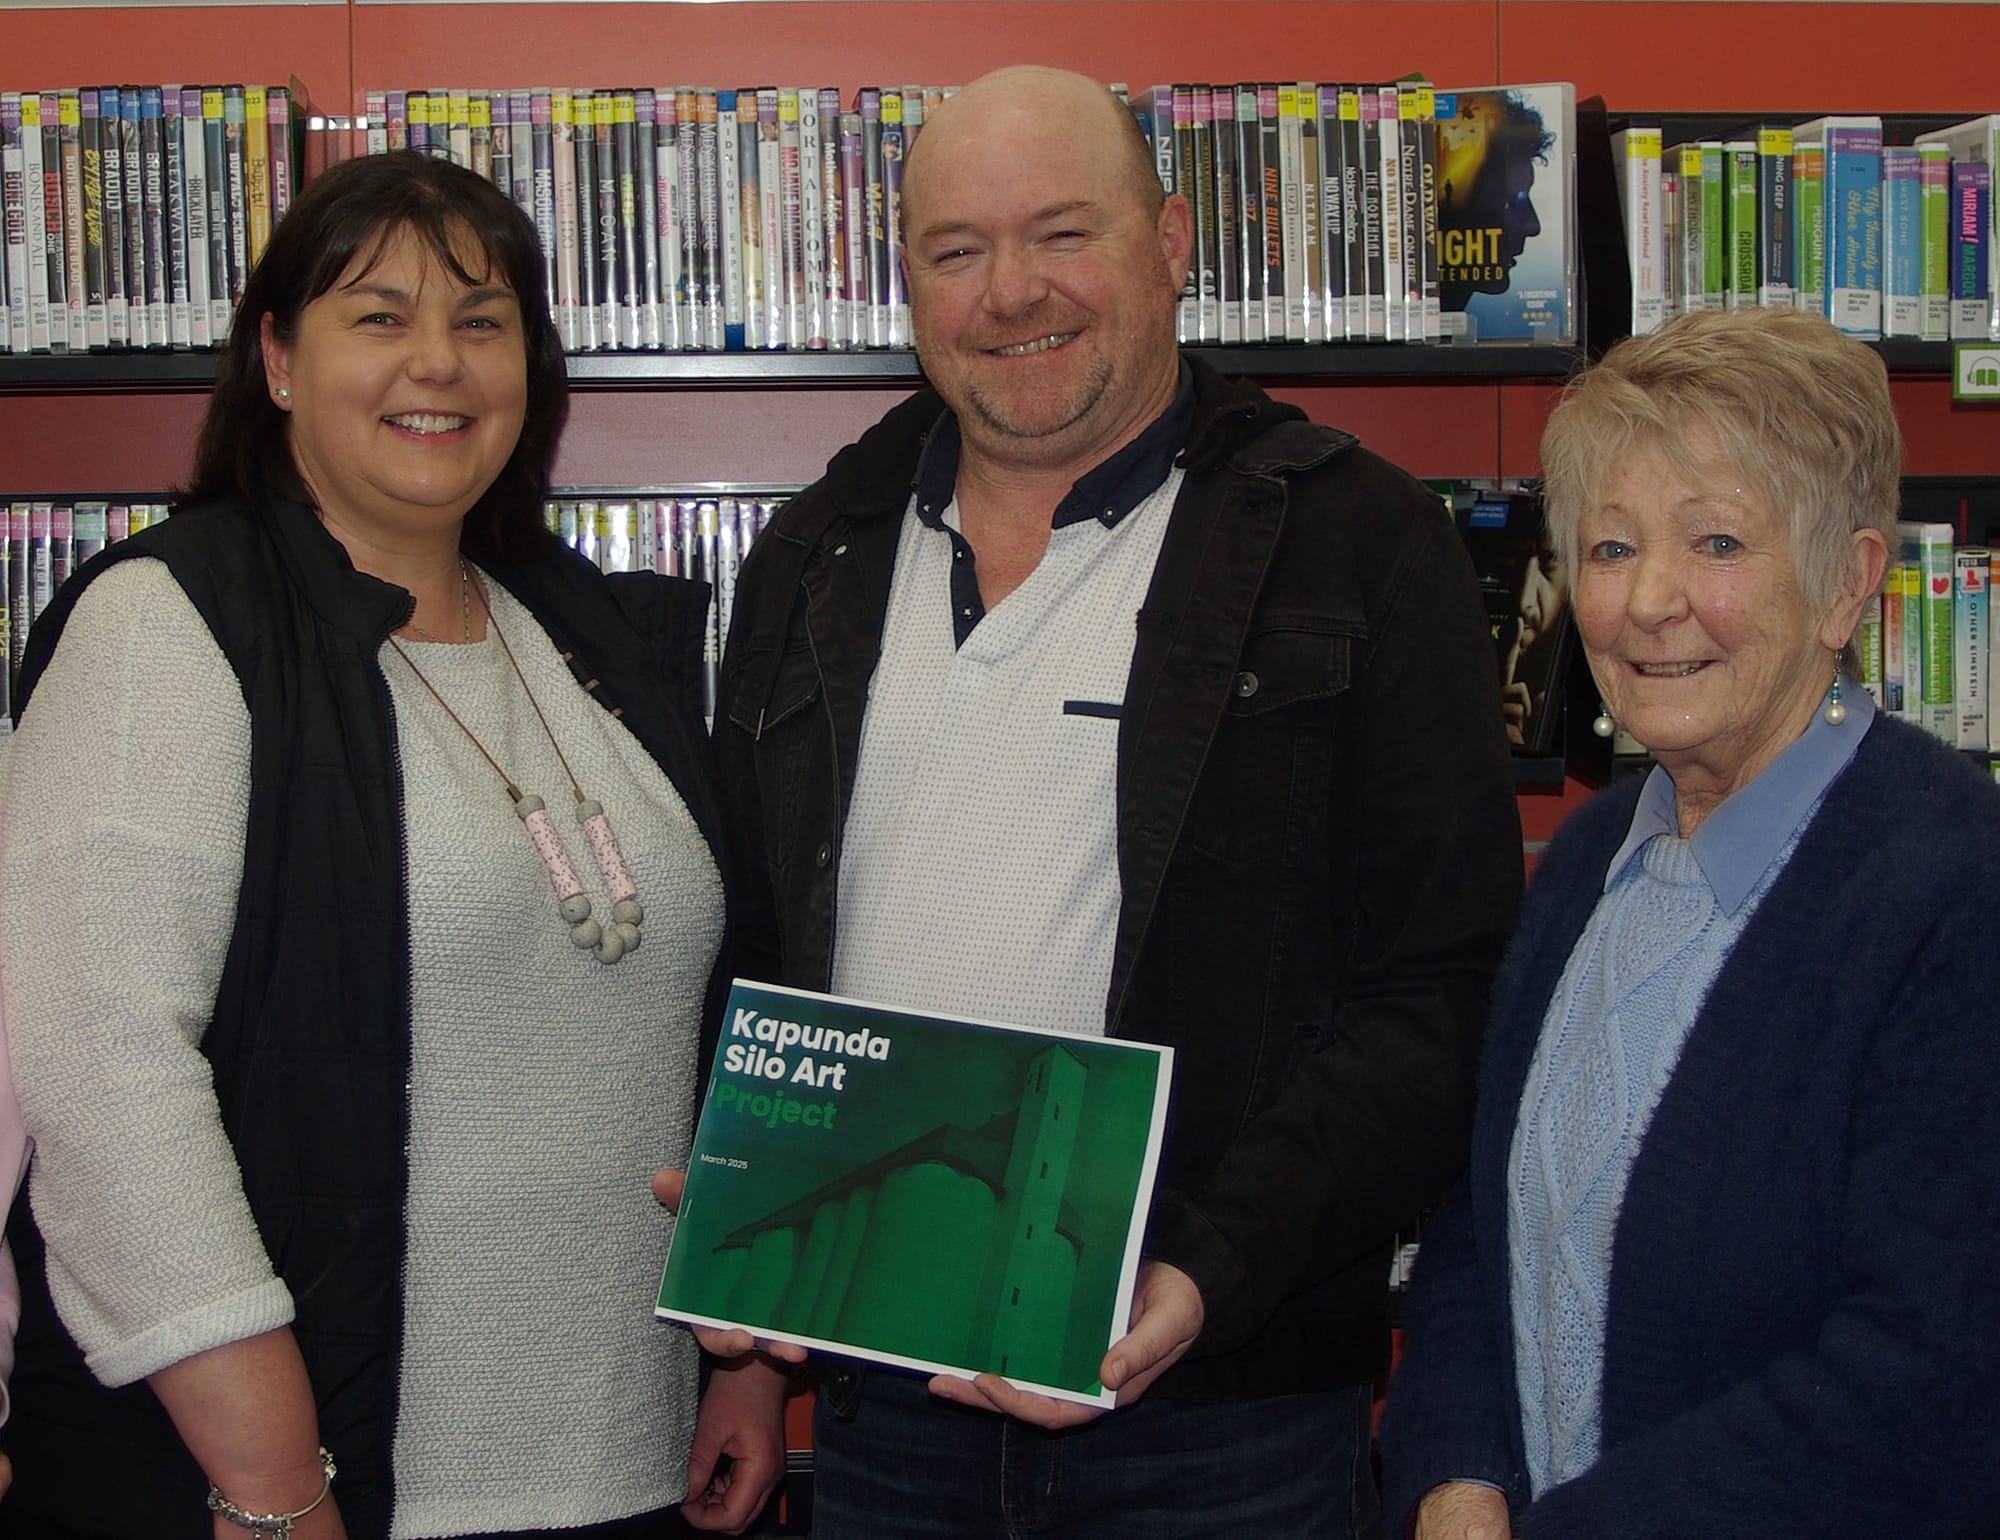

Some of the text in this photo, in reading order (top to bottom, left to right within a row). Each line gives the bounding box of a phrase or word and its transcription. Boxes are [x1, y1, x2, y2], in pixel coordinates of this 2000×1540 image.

[5, 171, 24, 207] BONE
[28, 163, 42, 211] BONES
[64, 156, 78, 183] BOTH
[229, 152, 243, 206] BUFFALO
[1386, 159, 1398, 174] NO
[1774, 154, 1785, 210] NING DEEP
[43, 172, 62, 231] BOSCH
[66, 187, 78, 215] SIDES
[167, 142, 182, 271] BREAKWATER
[189, 178, 204, 240] BRICKLAYER
[1265, 167, 1280, 266] NINE BULLETS
[1305, 183, 1317, 246] NITRAM
[1366, 171, 1379, 258] THE NORTHMAN
[68, 219, 78, 232] OF
[69, 235, 79, 252] THE
[1387, 220, 1399, 237] TO
[1437, 227, 1504, 267] IGHT
[31, 245, 43, 270] ALL
[1388, 241, 1400, 264] DIE
[1439, 266, 1505, 283] TENDED
[1968, 602, 1978, 698] OTHER EINSTEIN
[731, 1007, 892, 1061] Kapunda
[723, 1044, 848, 1092] Silo Art
[715, 1083, 837, 1130] Project
[700, 1152, 749, 1171] March 2025
